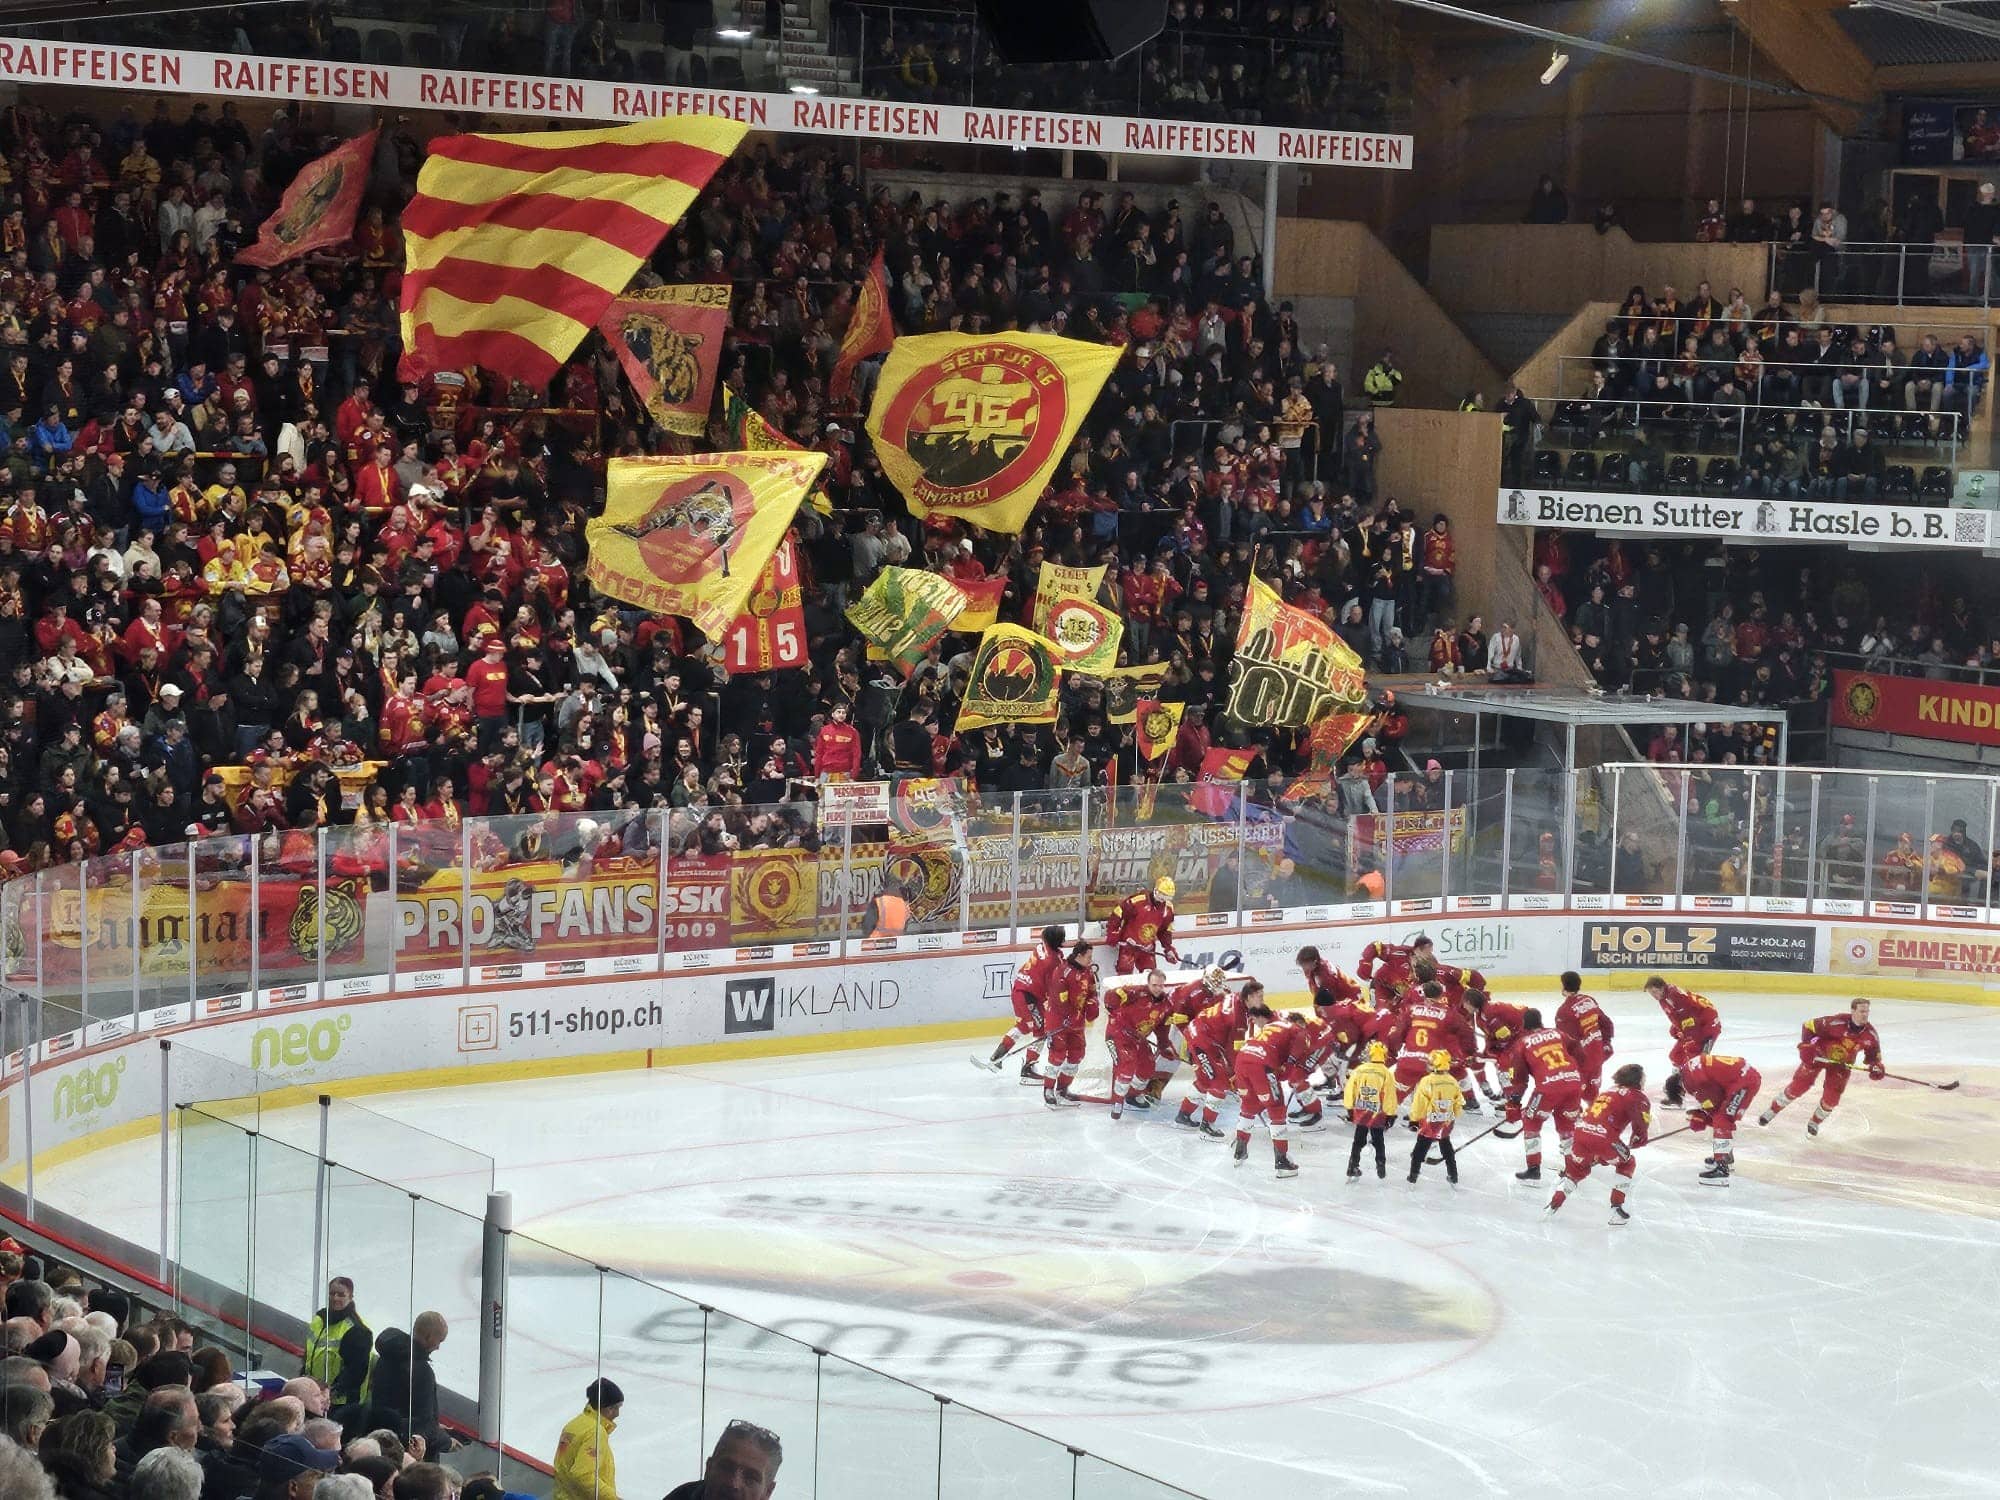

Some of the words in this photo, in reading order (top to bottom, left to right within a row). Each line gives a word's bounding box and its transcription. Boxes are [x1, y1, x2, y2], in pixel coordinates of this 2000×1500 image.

[0, 43, 181, 85] RAIFFEISEN
[213, 59, 389, 98] RAIFFEISEN
[420, 73, 584, 112] RAIFFEISEN
[612, 87, 767, 125] RAIFFEISEN
[793, 100, 939, 136] RAIFFEISEN
[964, 113, 1102, 147] RAIFFEISEN
[1125, 122, 1256, 155] RAIFFEISEN
[1278, 132, 1402, 164] RAIFFEISEN
[944, 392, 1012, 428] 46
[1537, 495, 1644, 525] Bienen
[1652, 501, 1744, 530] Sutter
[1788, 507, 1880, 536] Hasle
[1890, 511, 1918, 538] b.
[1922, 513, 1950, 540] B.
[87, 909, 269, 956] angnau
[396, 894, 496, 950] PRO
[531, 883, 655, 939] FANS
[1440, 924, 1510, 954] Stähli
[1591, 926, 1717, 953] HOLZ
[1730, 936, 1759, 946] BALZ
[1760, 937, 1789, 948] HOLZ
[1790, 939, 1806, 948] AG
[1597, 953, 1632, 964] ISCH
[1636, 953, 1709, 965] HEIMELIG
[992, 971, 1009, 991] IT
[509, 1000, 663, 1038] 511-shop.ch
